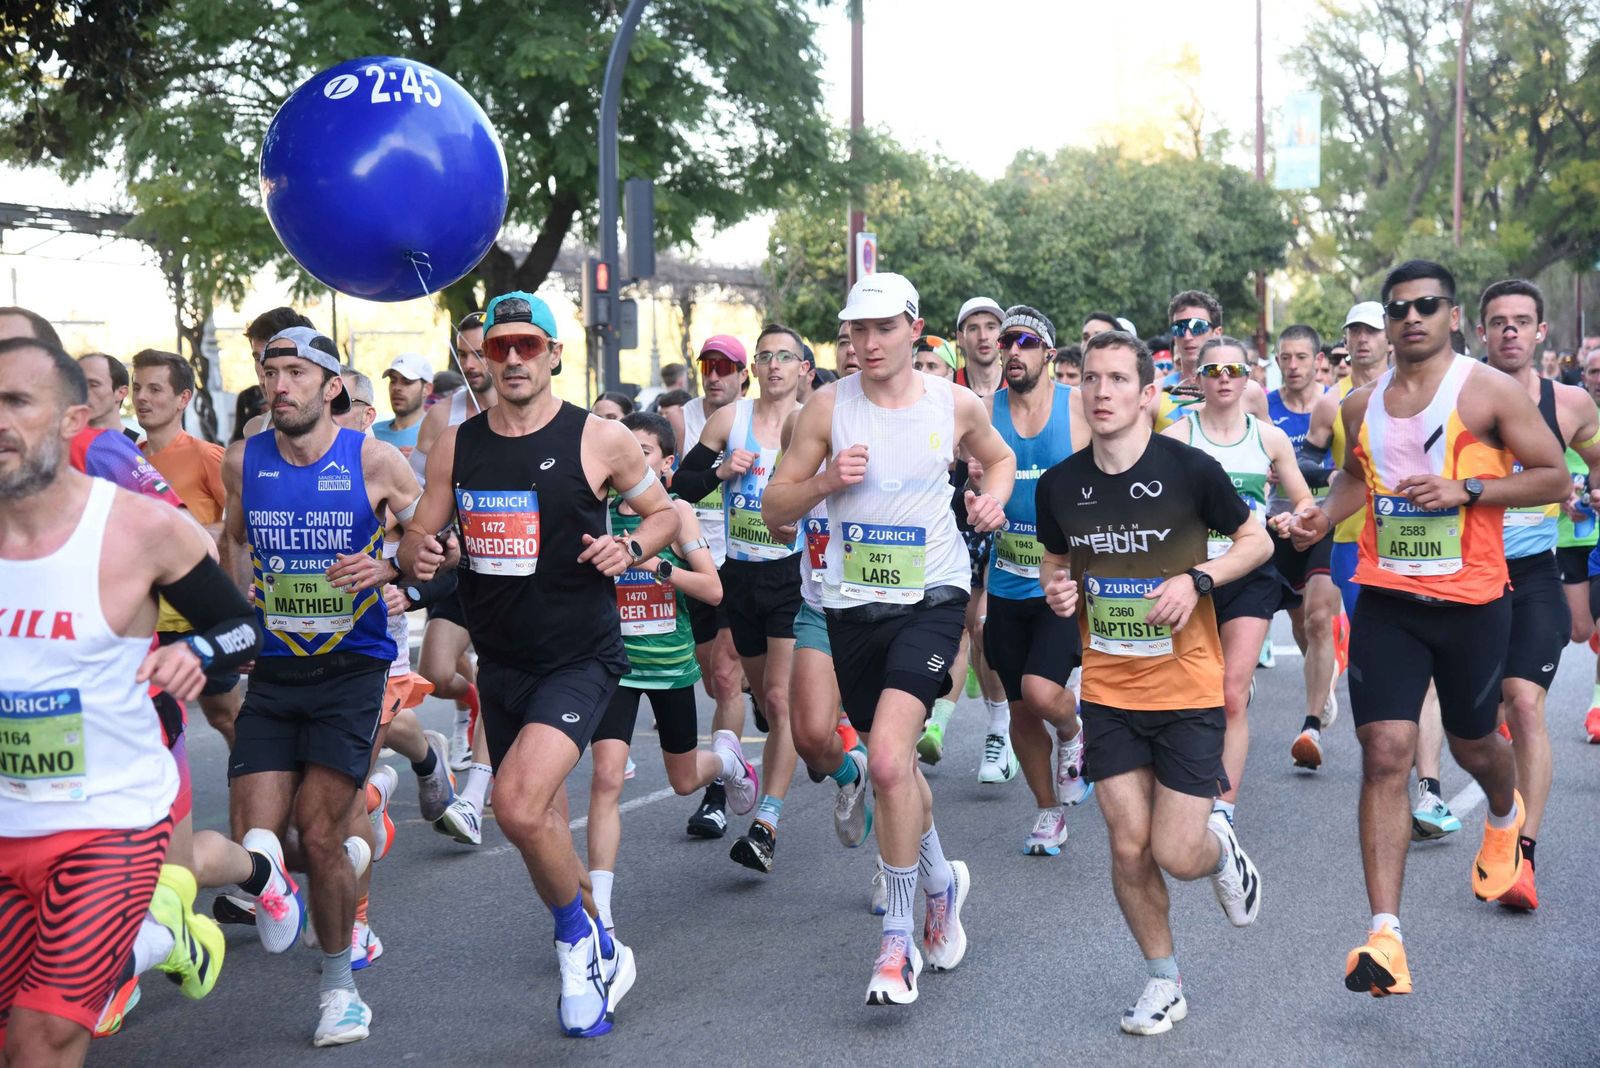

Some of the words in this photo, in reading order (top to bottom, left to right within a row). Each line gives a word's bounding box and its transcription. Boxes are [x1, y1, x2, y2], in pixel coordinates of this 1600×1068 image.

[365, 65, 442, 107] 2:45
[319, 480, 351, 490] RUNNING
[478, 496, 528, 508] ZURICH
[248, 510, 295, 526] CROISSY
[305, 511, 354, 527] CHATOU
[482, 521, 506, 533] 1472
[1096, 523, 1139, 533] TEAM
[1400, 525, 1426, 536] 2583
[252, 528, 353, 550] ATHLETISME
[868, 530, 916, 542] ZURICH
[465, 535, 537, 555] PAREDERO
[1015, 540, 1034, 550] 1943
[1390, 541, 1442, 557] ARJUN
[290, 559, 340, 570] ZURICH
[869, 553, 892, 564] 2471
[862, 567, 901, 585] LARS
[293, 582, 318, 594] 1761
[1104, 583, 1153, 594] ZURICH
[625, 591, 647, 601] 1470
[274, 596, 344, 614] MATHIEU
[620, 605, 647, 619] CER
[650, 602, 674, 617] TIN
[1109, 606, 1135, 617] 2360
[1093, 617, 1165, 638] BAPTISTE
[0, 731, 31, 745] 164
